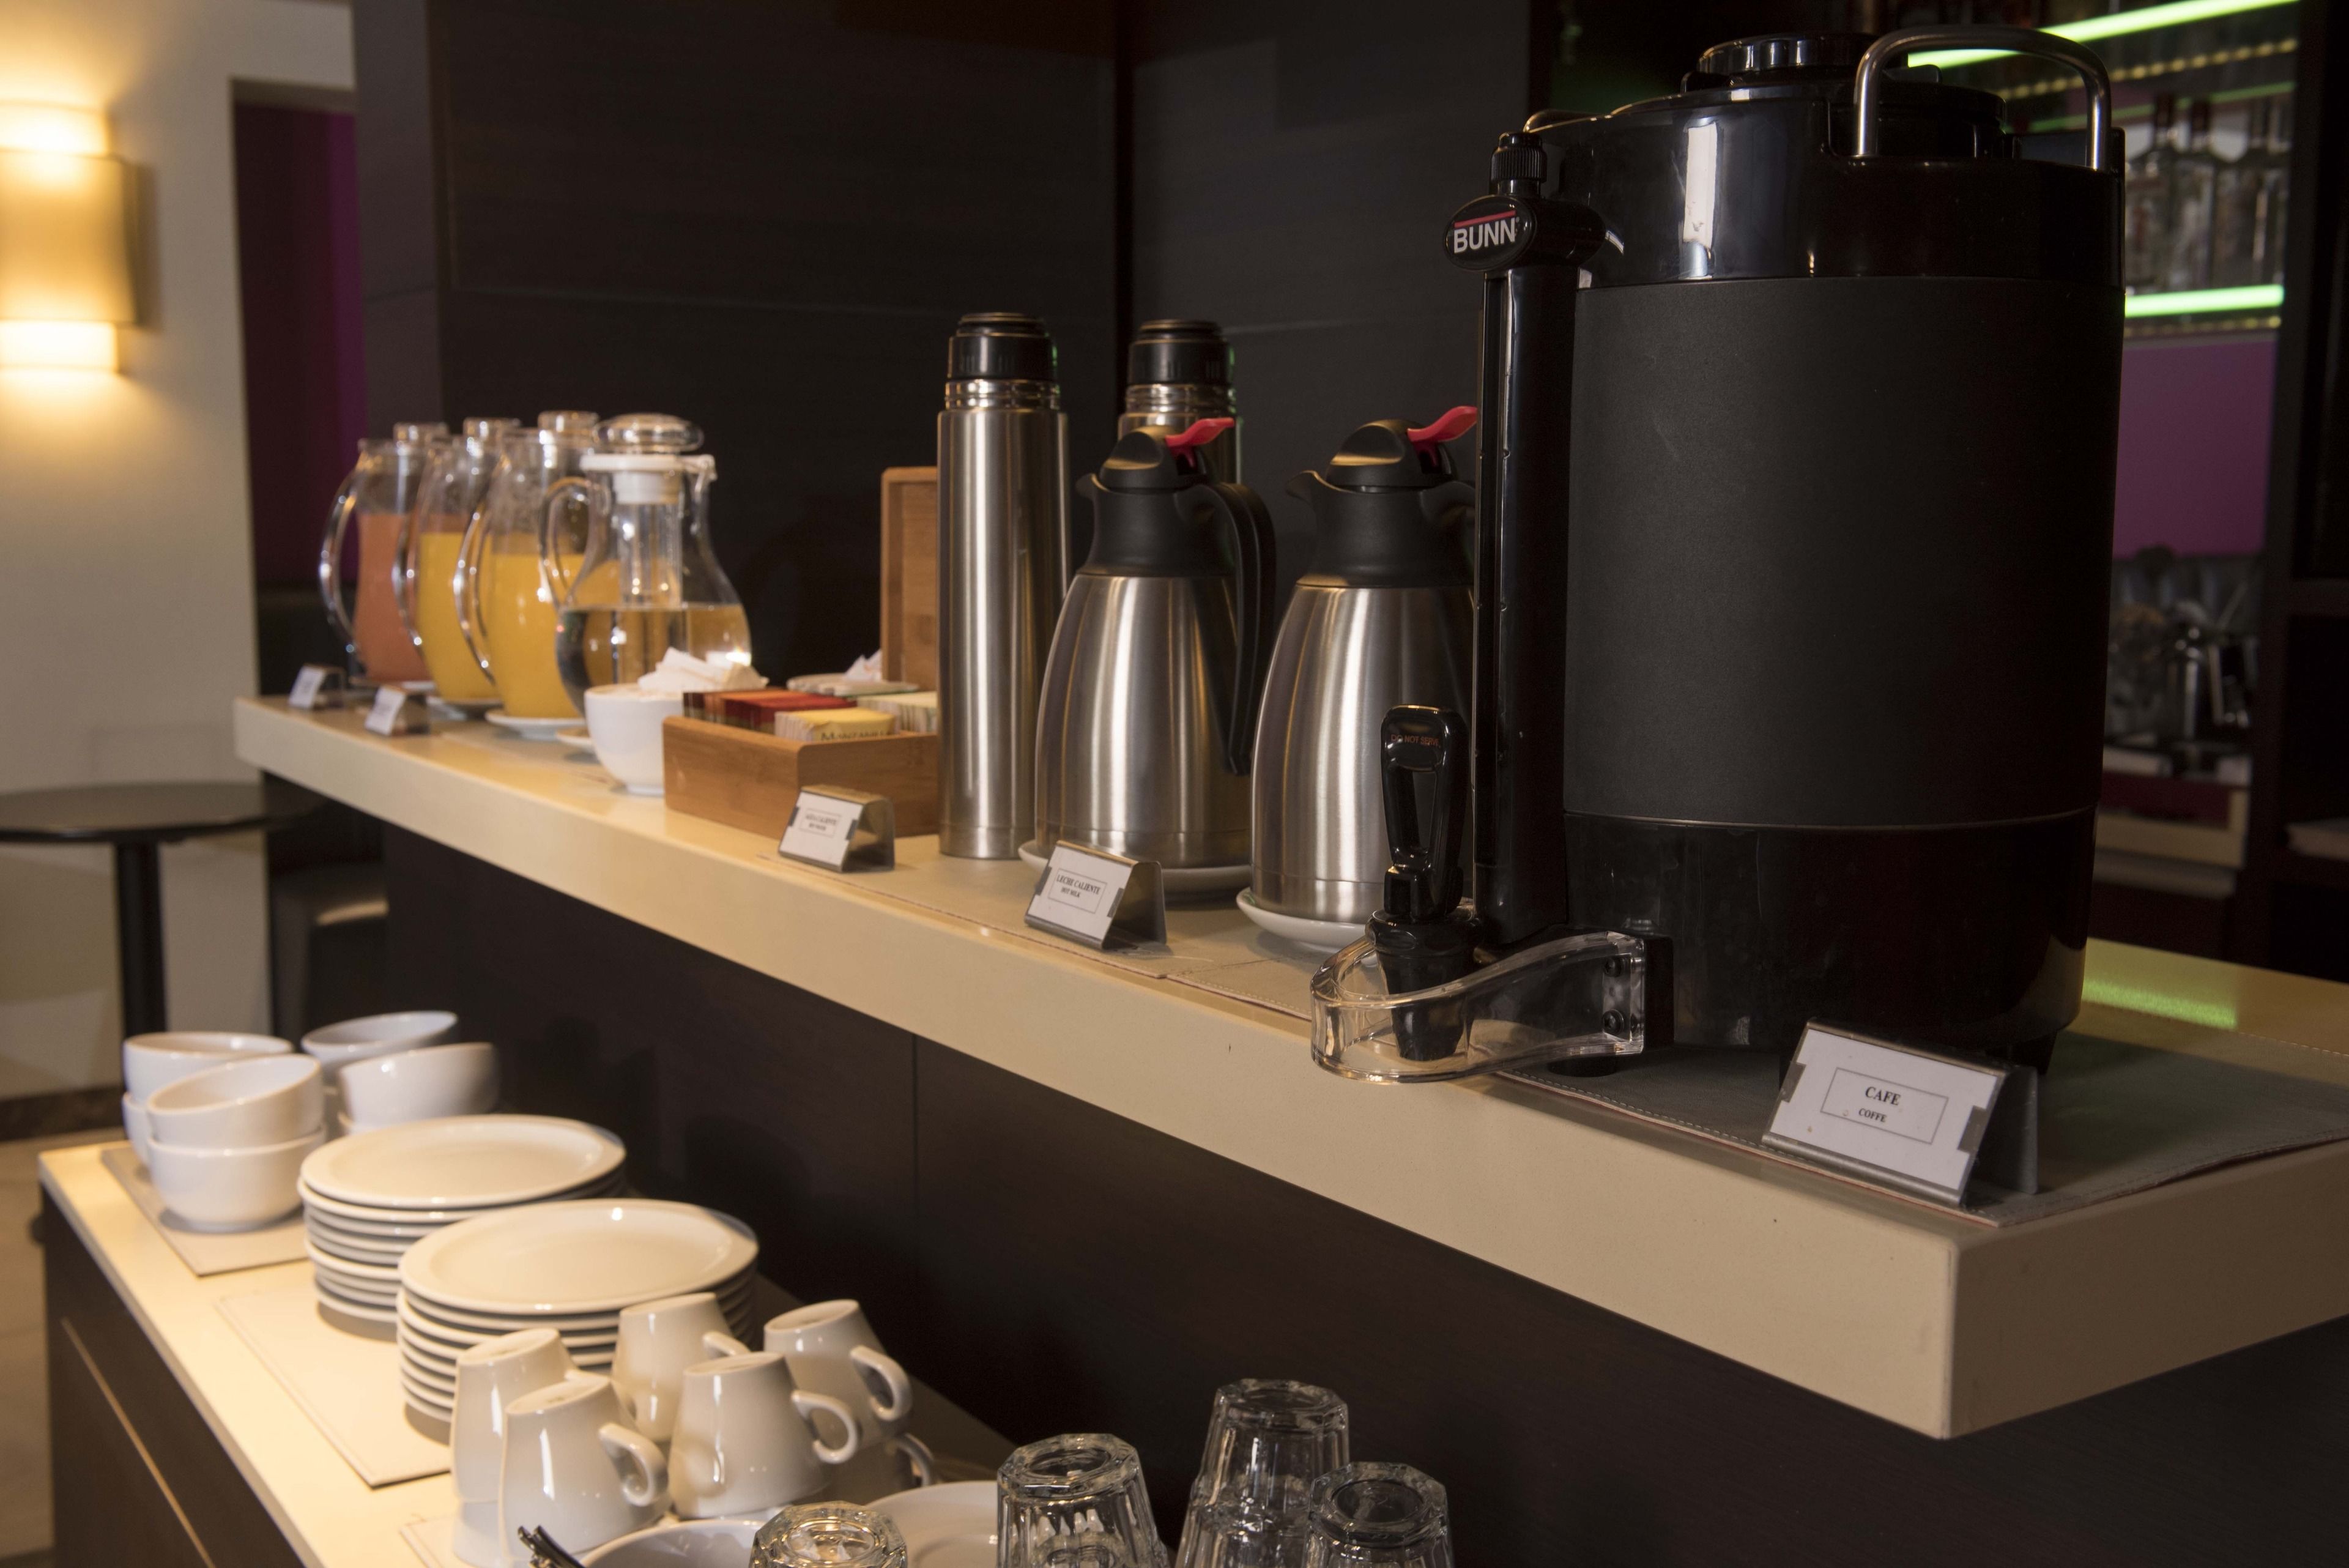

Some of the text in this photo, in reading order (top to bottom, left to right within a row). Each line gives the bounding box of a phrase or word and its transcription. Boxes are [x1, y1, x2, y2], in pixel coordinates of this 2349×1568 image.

[1454, 217, 1516, 254] BUNN
[1390, 734, 1403, 743] DO
[1405, 735, 1419, 743] NOT
[1056, 874, 1101, 895] LECHE CALIENTE
[1865, 1086, 1901, 1106] CAFE
[1858, 1108, 1887, 1123] COFFE
